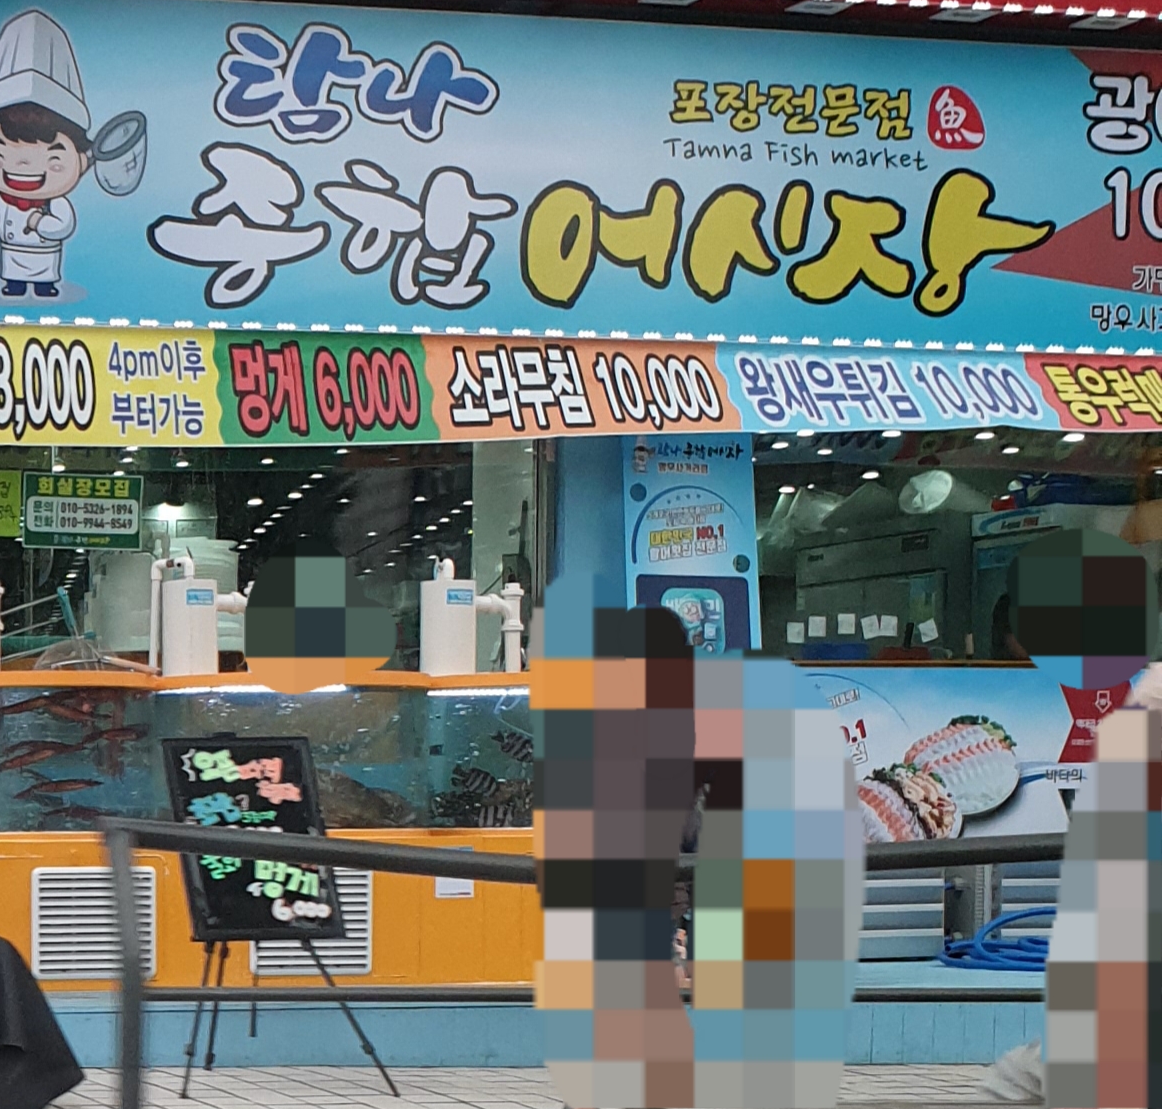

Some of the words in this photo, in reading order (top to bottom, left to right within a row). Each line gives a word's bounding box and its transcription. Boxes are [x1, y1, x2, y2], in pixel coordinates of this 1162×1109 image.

[213, 22, 500, 143] 탐나
[669, 79, 913, 141] 포장전문점
[1083, 72, 1162, 155] 광
[932, 89, 985, 146] 魚
[663, 137, 753, 162] Tamna
[764, 140, 818, 167] Fish
[830, 148, 929, 172] market
[521, 168, 1056, 318] 어시장
[108, 339, 206, 382] 4pm이후
[229, 340, 310, 438] 멍게
[315, 347, 422, 441] 6,000
[449, 345, 595, 432] 소라무침
[593, 350, 724, 431] 10,000
[735, 352, 926, 426] 왕새우튀김
[911, 358, 1042, 428] 10,000
[110, 391, 206, 437] 부터가능
